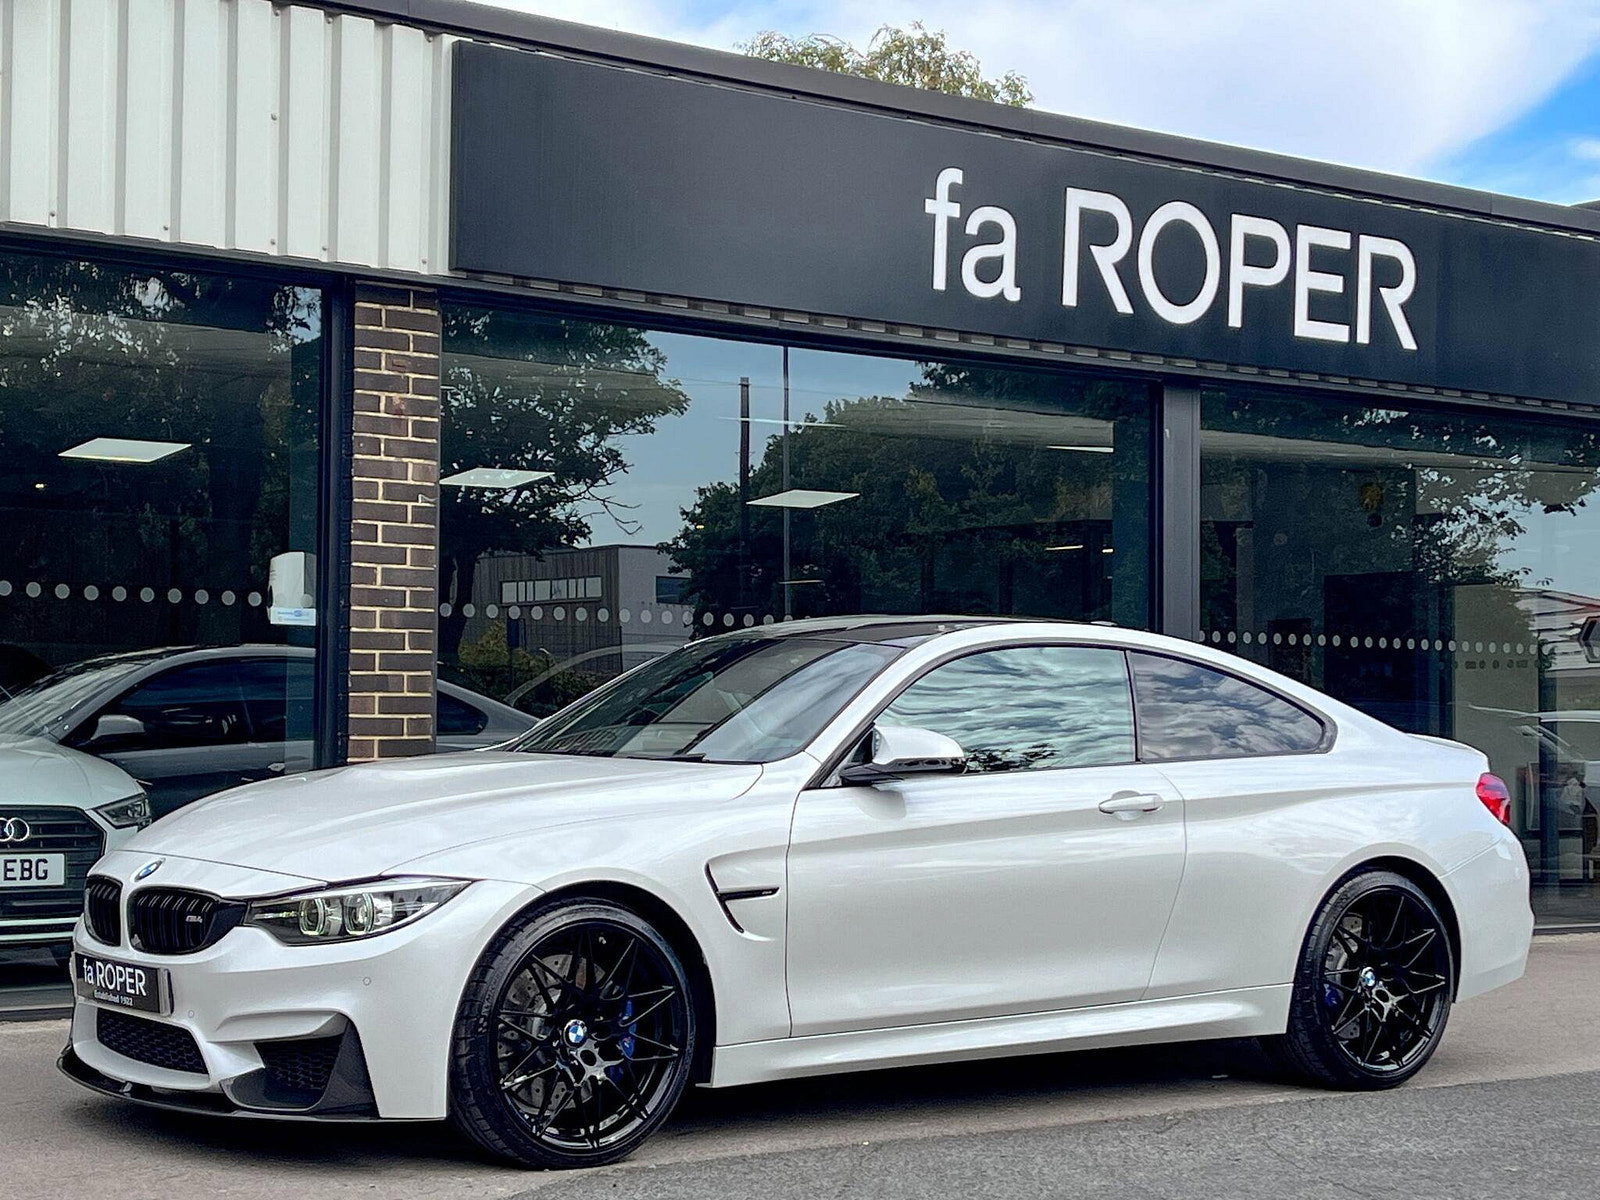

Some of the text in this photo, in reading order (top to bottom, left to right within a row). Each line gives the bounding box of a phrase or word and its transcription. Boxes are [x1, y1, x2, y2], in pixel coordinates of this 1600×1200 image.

[924, 168, 1418, 351] fa ROPER
[3, 858, 49, 881] EBG
[83, 958, 147, 996] fa ROPER
